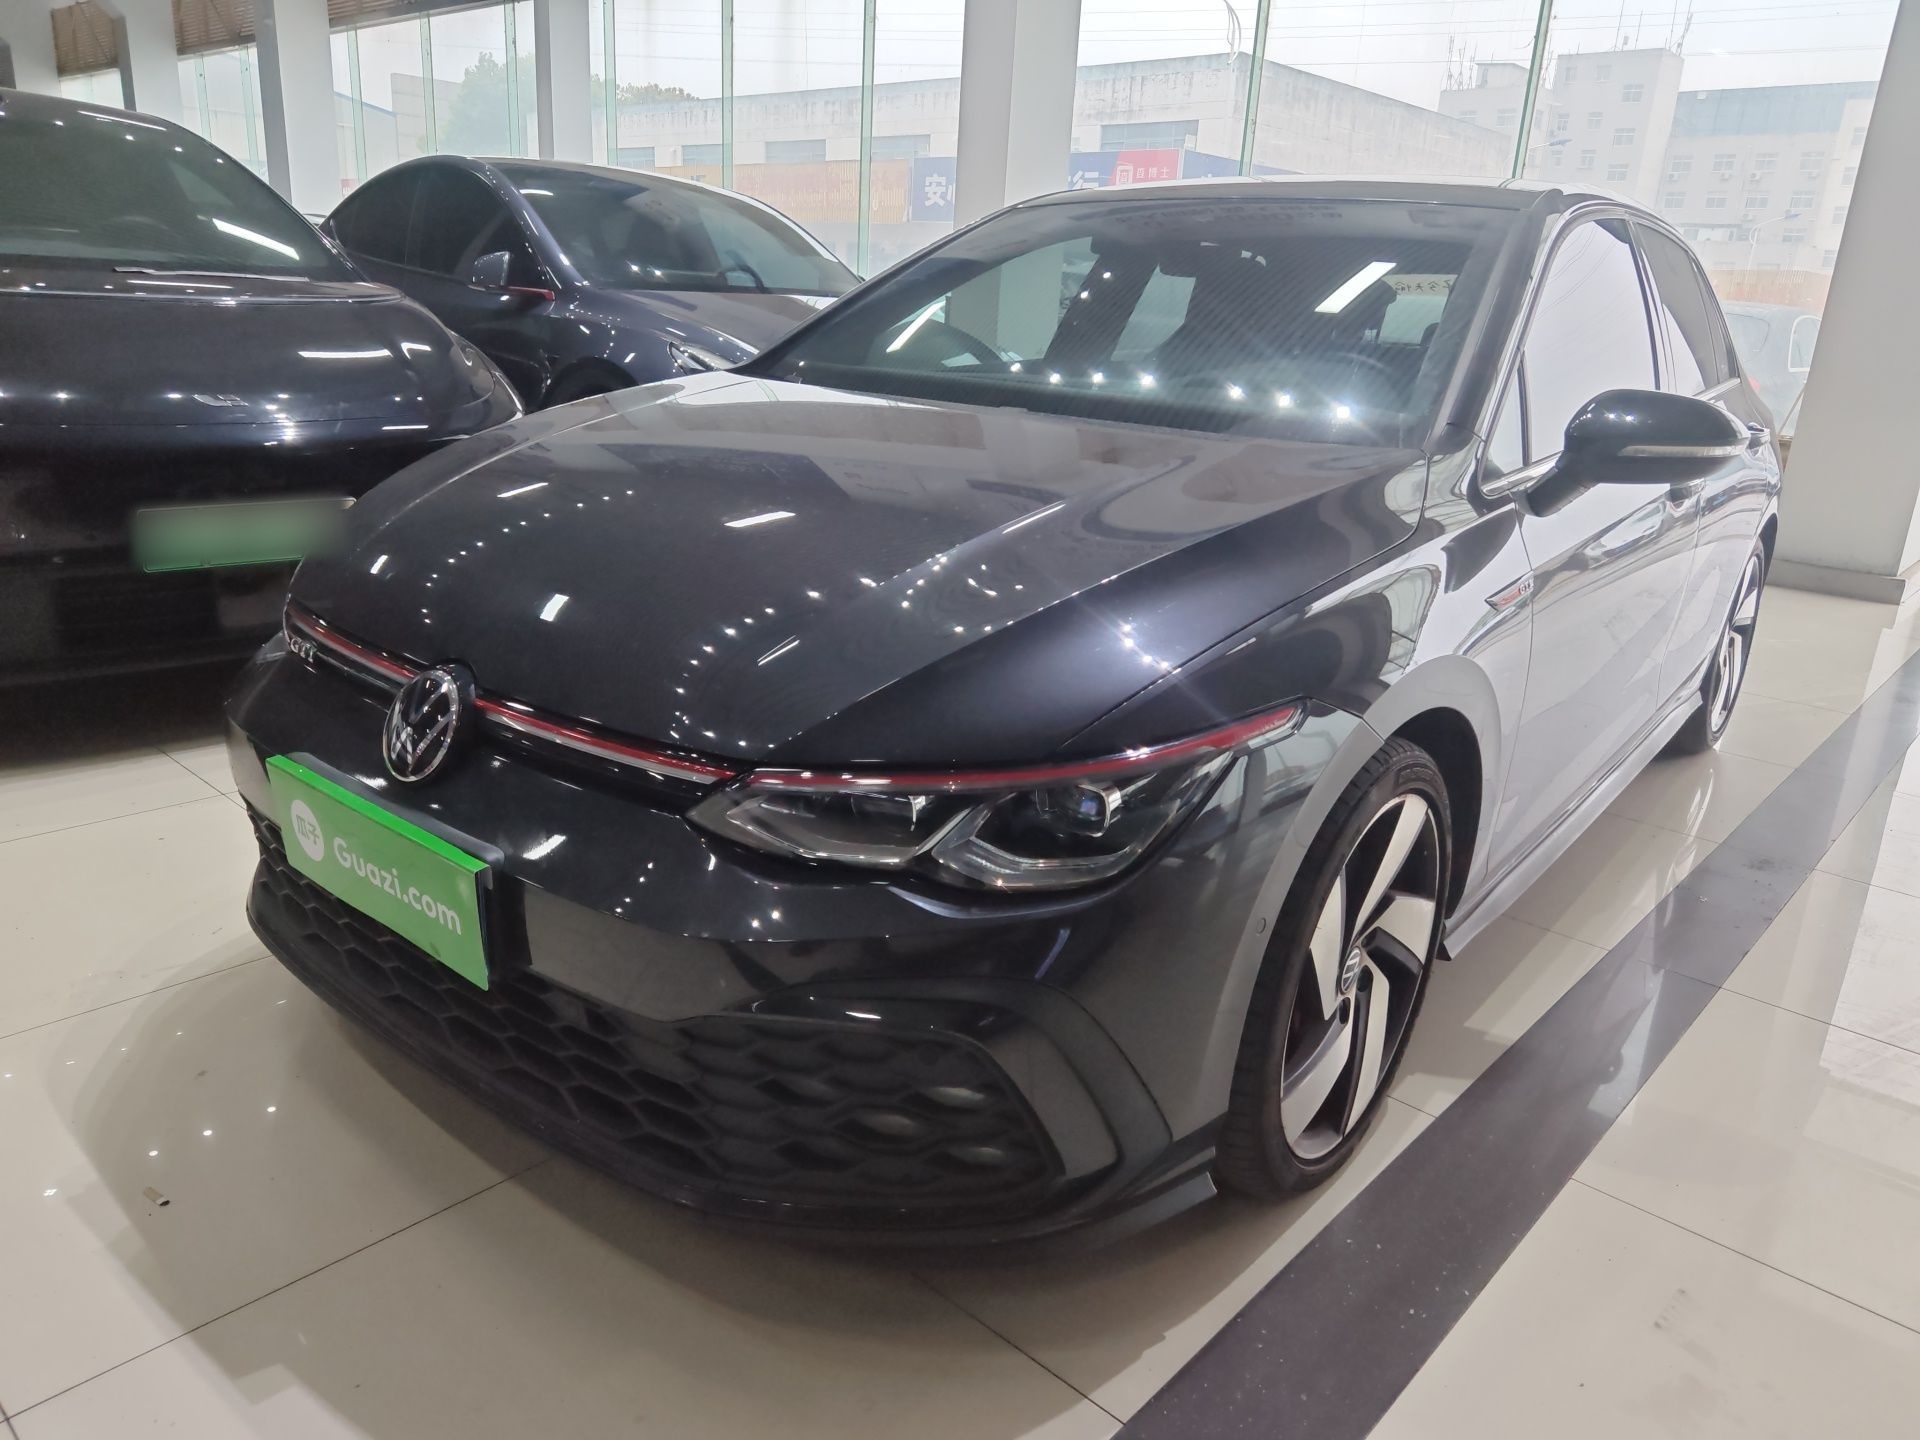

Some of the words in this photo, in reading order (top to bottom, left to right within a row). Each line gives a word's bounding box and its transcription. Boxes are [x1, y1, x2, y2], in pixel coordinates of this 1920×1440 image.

[925, 173, 954, 207] 安
[290, 637, 315, 663] GTI
[333, 837, 462, 935] Guazi.com
